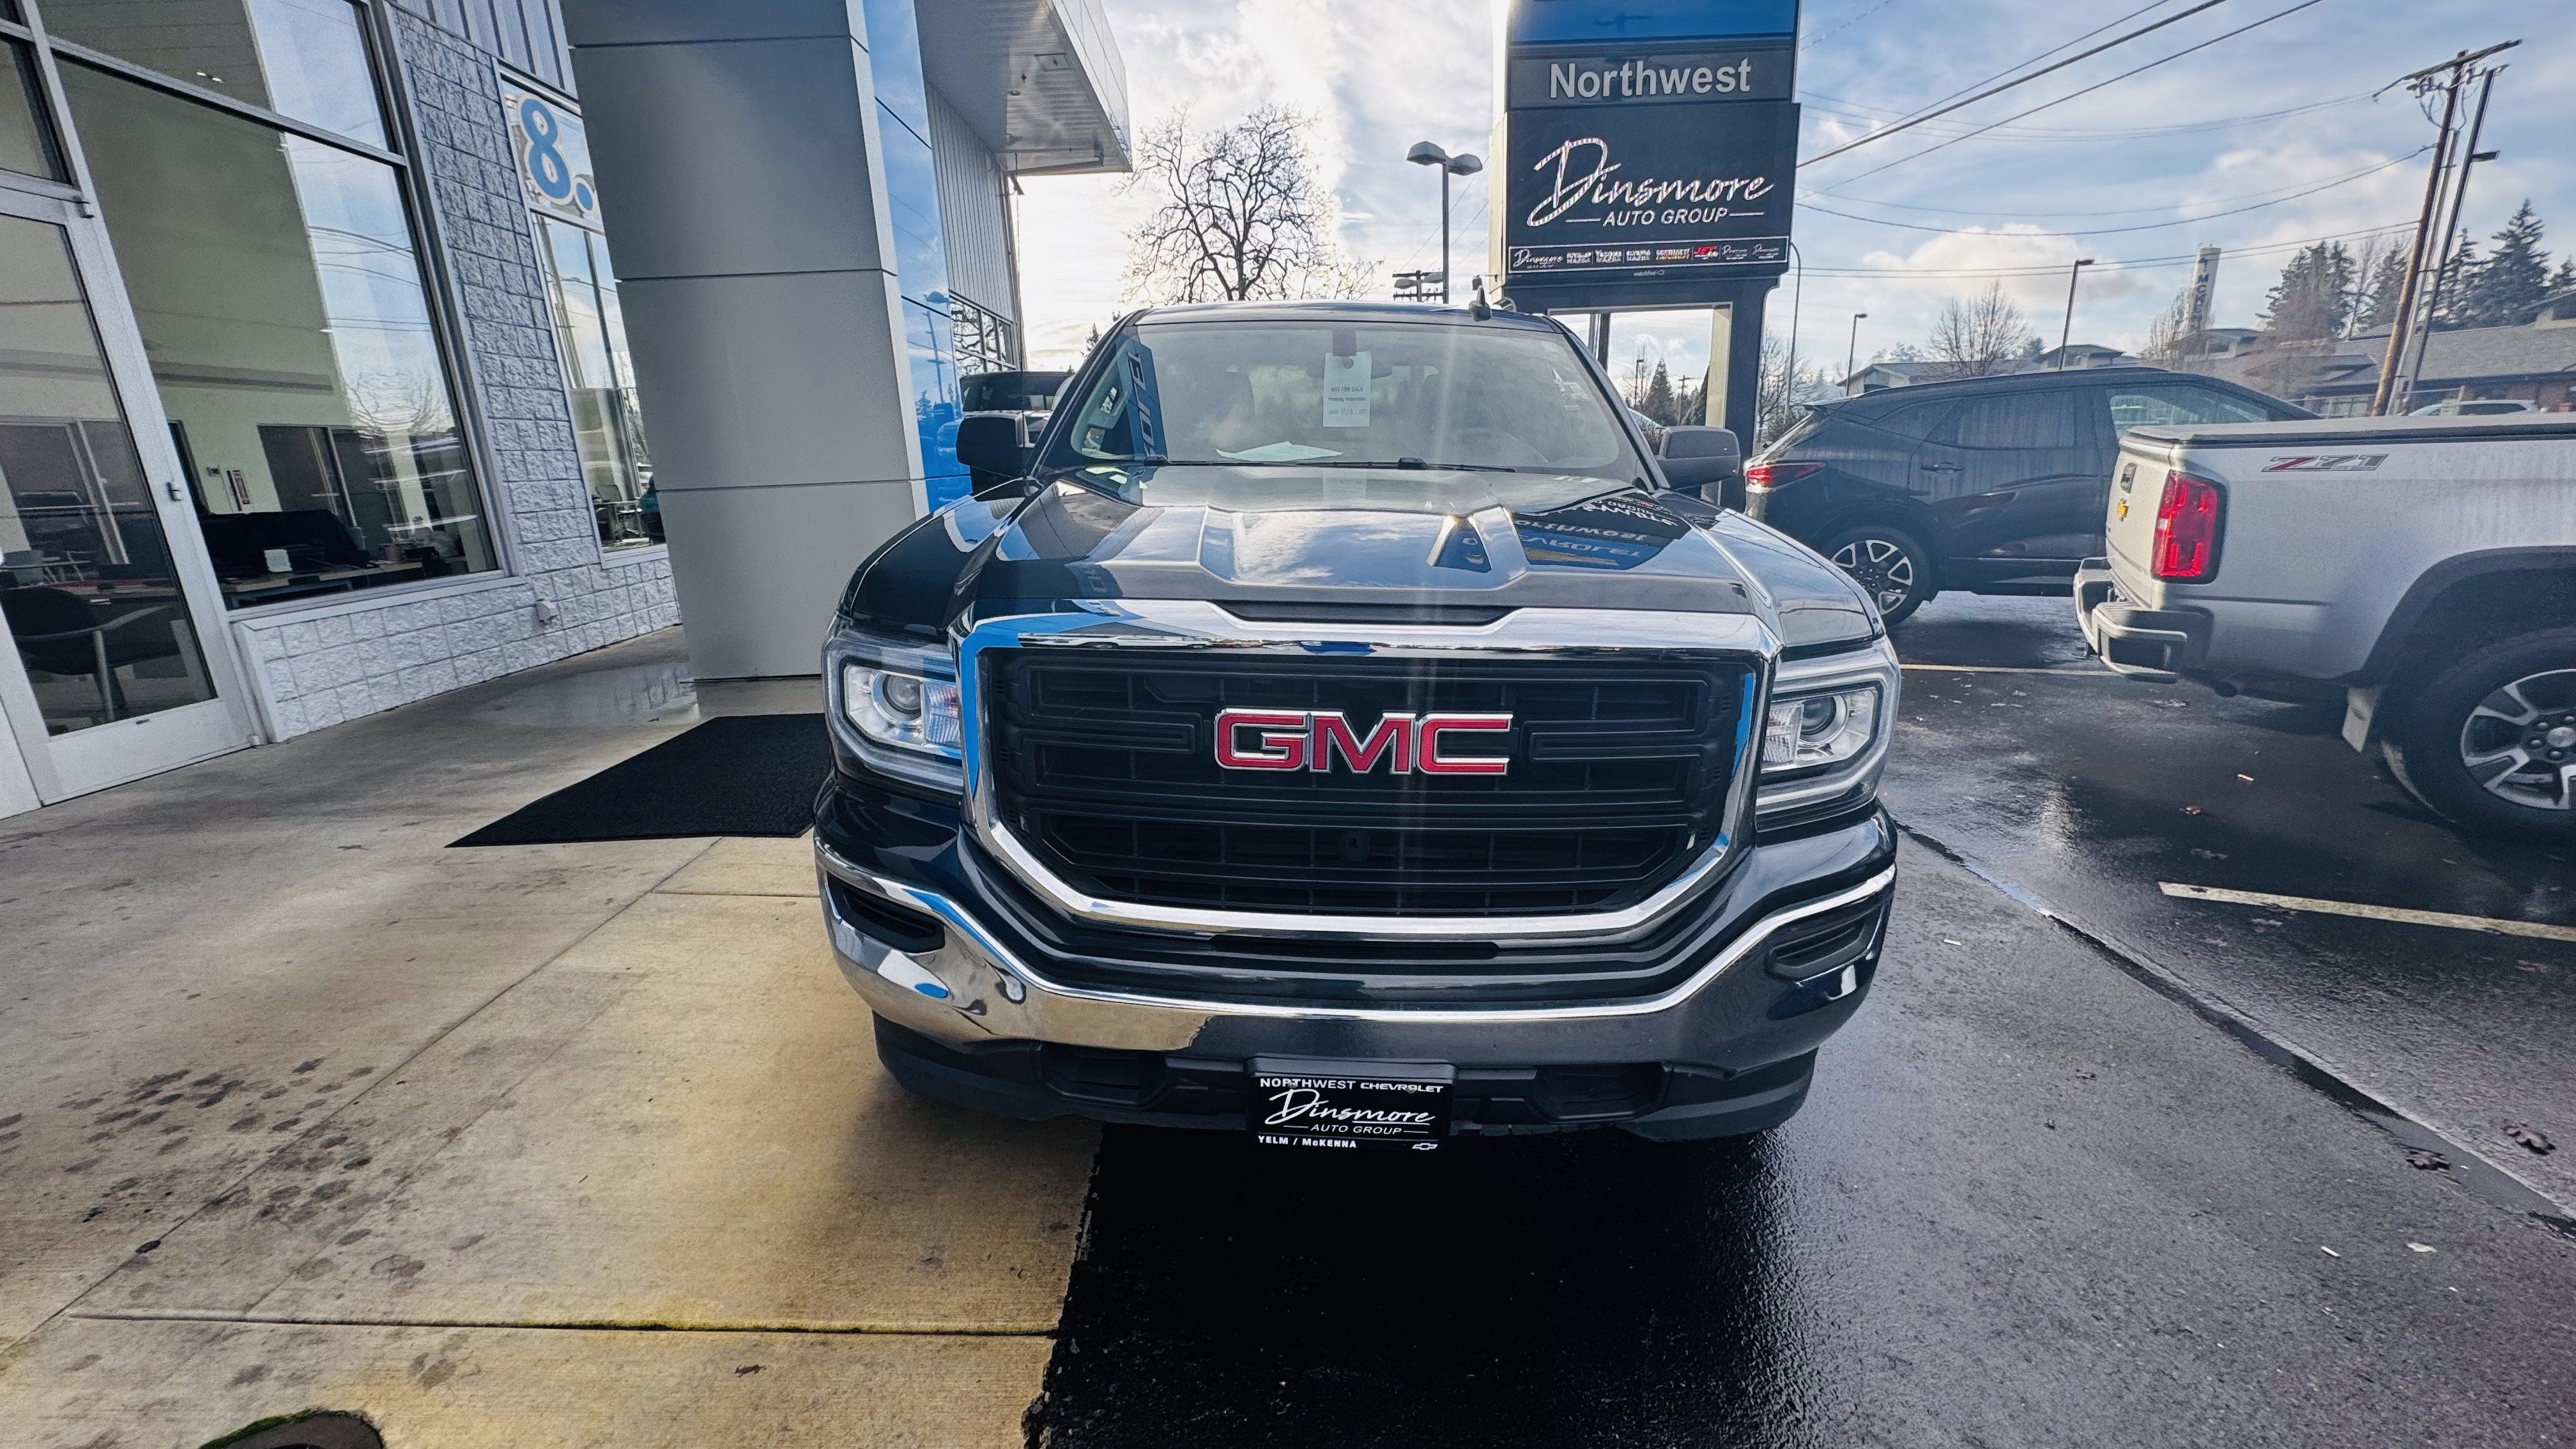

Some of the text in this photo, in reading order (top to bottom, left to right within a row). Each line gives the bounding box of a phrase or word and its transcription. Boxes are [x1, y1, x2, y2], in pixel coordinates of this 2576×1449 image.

[1551, 57, 1752, 98] Northwest
[1527, 137, 1774, 227] Dinsmore
[1603, 207, 1728, 227] AUTO GROUP
[2260, 454, 2389, 472] Z71
[1215, 707, 1514, 776] GMC
[1260, 1078, 1444, 1093] NORTHWEST CHEVROLET
[1264, 1088, 1436, 1125] Dinsmore
[1310, 1124, 1402, 1135] AUTO GROUP
[1258, 1135, 1289, 1145] YELM
[1302, 1138, 1357, 1148] McKENNA
